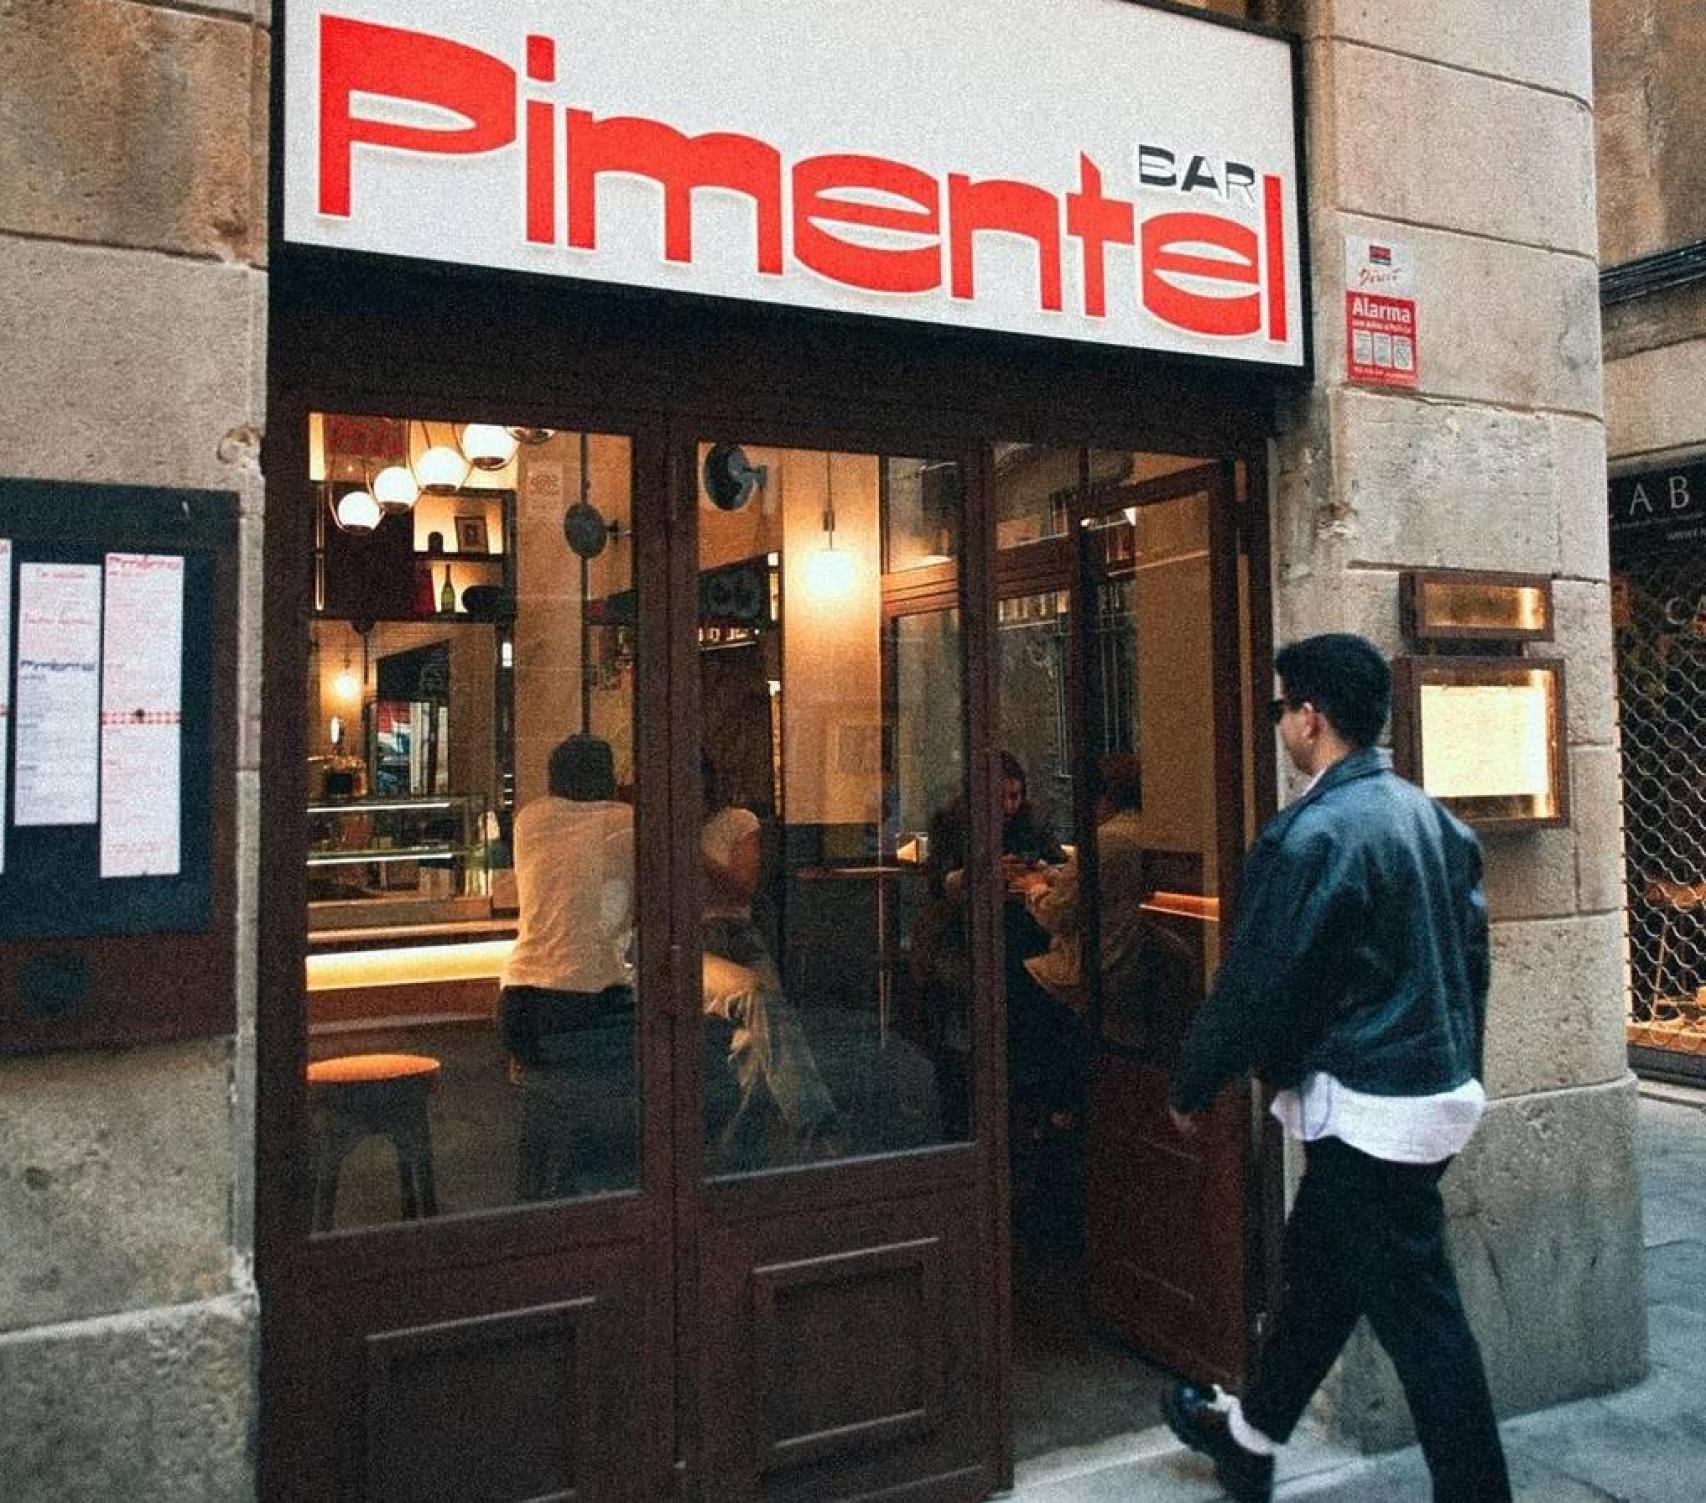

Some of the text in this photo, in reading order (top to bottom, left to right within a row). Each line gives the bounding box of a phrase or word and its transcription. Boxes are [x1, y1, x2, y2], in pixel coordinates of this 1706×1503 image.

[319, 14, 1287, 341] Pimentel
[1138, 143, 1256, 202] BAR
[1352, 296, 1412, 324] Alarma
[1607, 475, 1690, 517] AB
